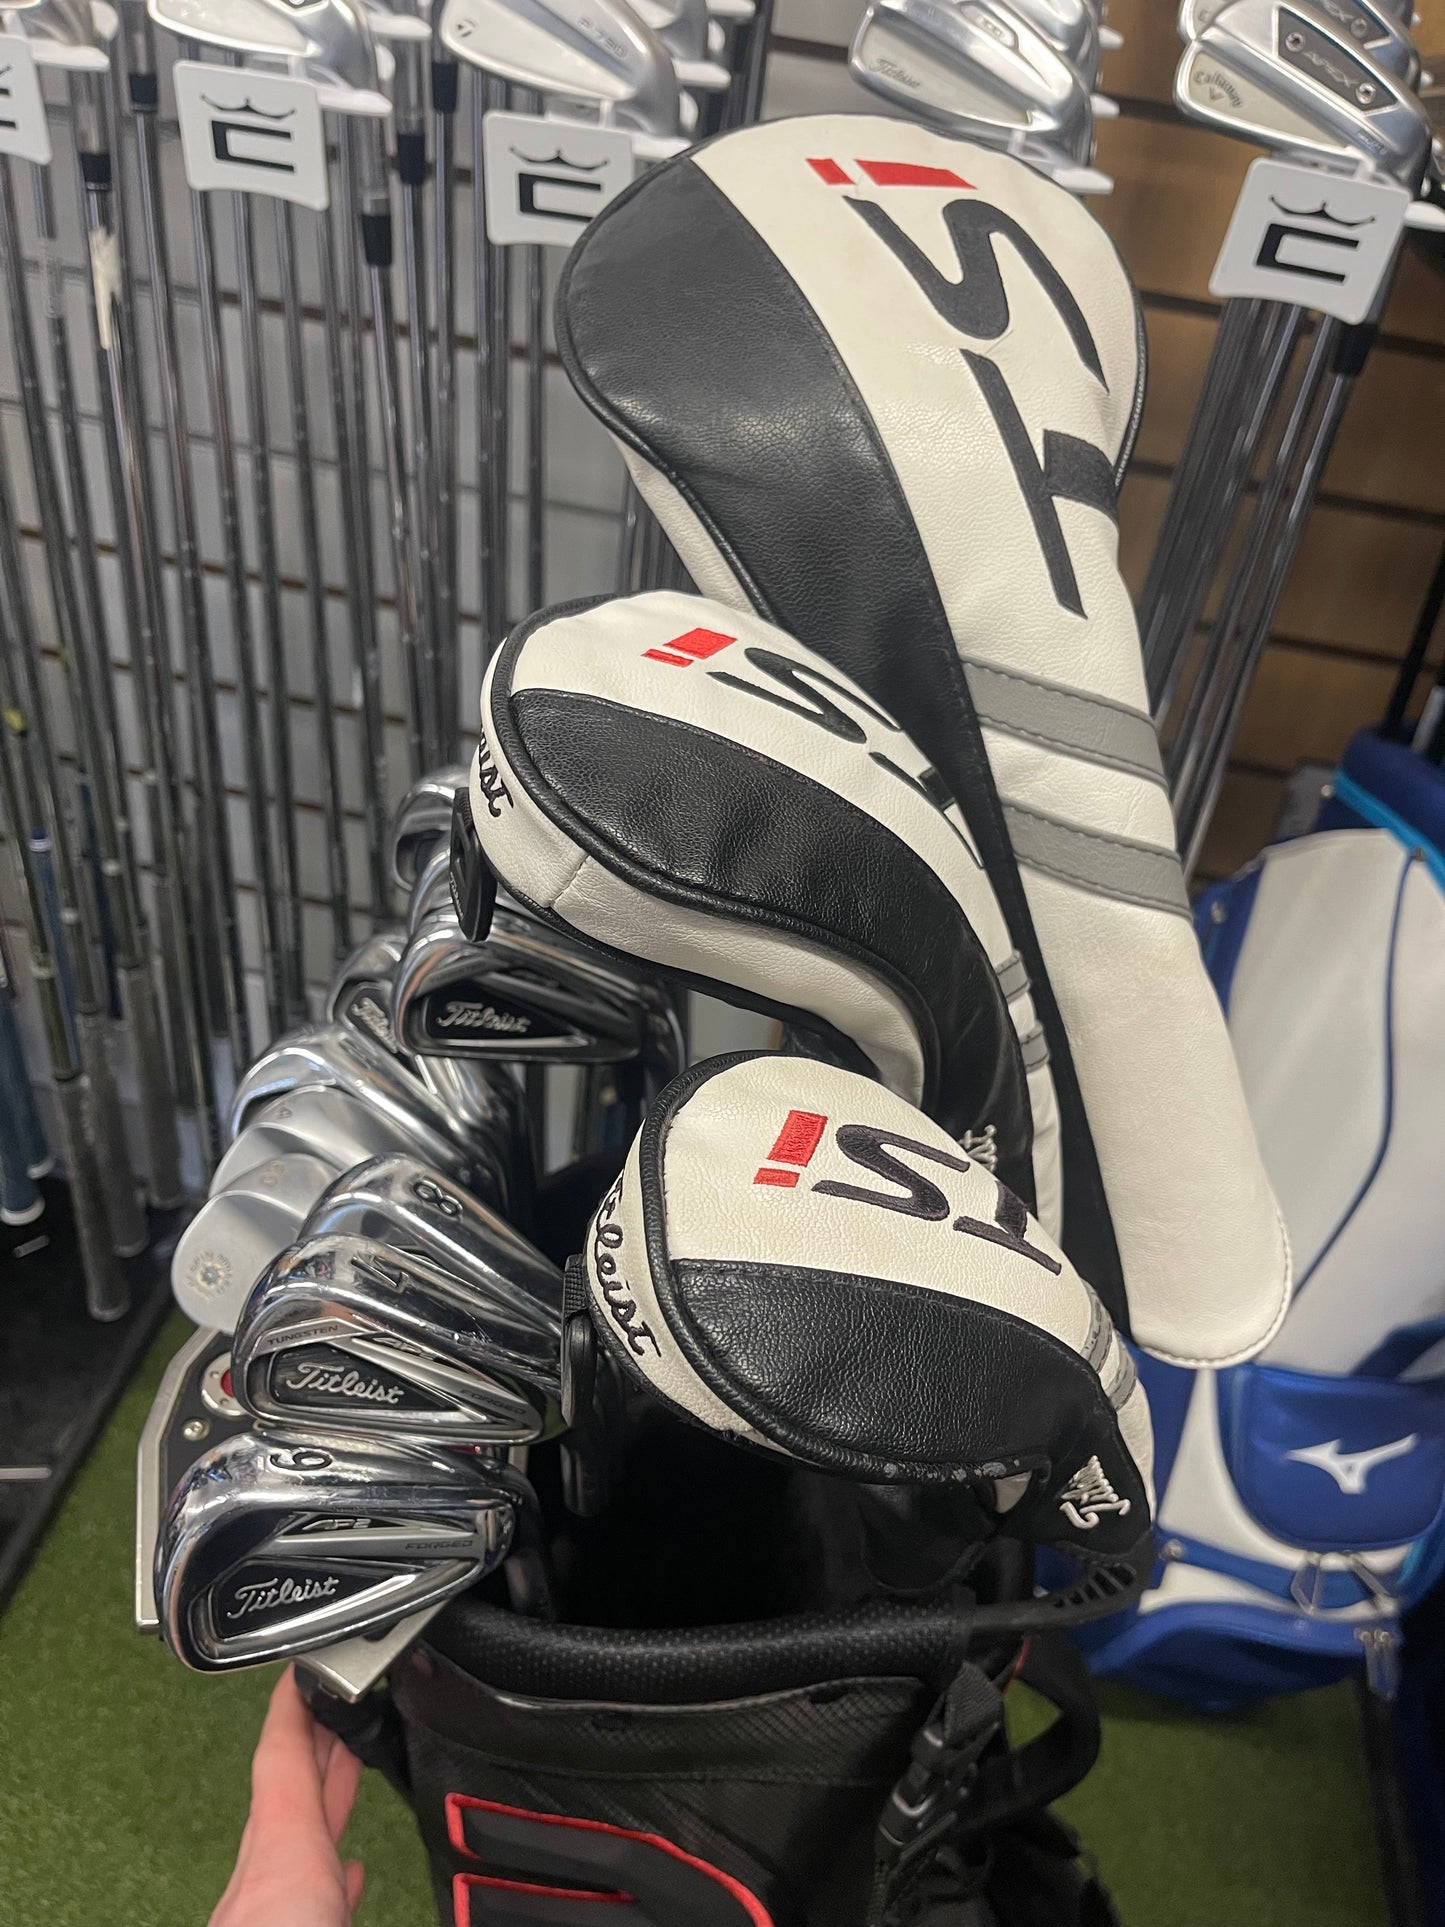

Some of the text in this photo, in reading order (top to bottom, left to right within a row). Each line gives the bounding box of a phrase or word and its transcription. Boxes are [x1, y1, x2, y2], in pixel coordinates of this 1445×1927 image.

[1193, 71, 1242, 108] Callaway
[412, 1179, 464, 1218] 8
[350, 1254, 409, 1293] 7
[266, 1323, 339, 1346] TUNGSTEN
[285, 1360, 405, 1405] Titleist
[459, 1387, 527, 1416] FORGED
[302, 1517, 372, 1532] AP2
[405, 1539, 474, 1551] FORGED
[226, 1574, 341, 1621] Titleist
